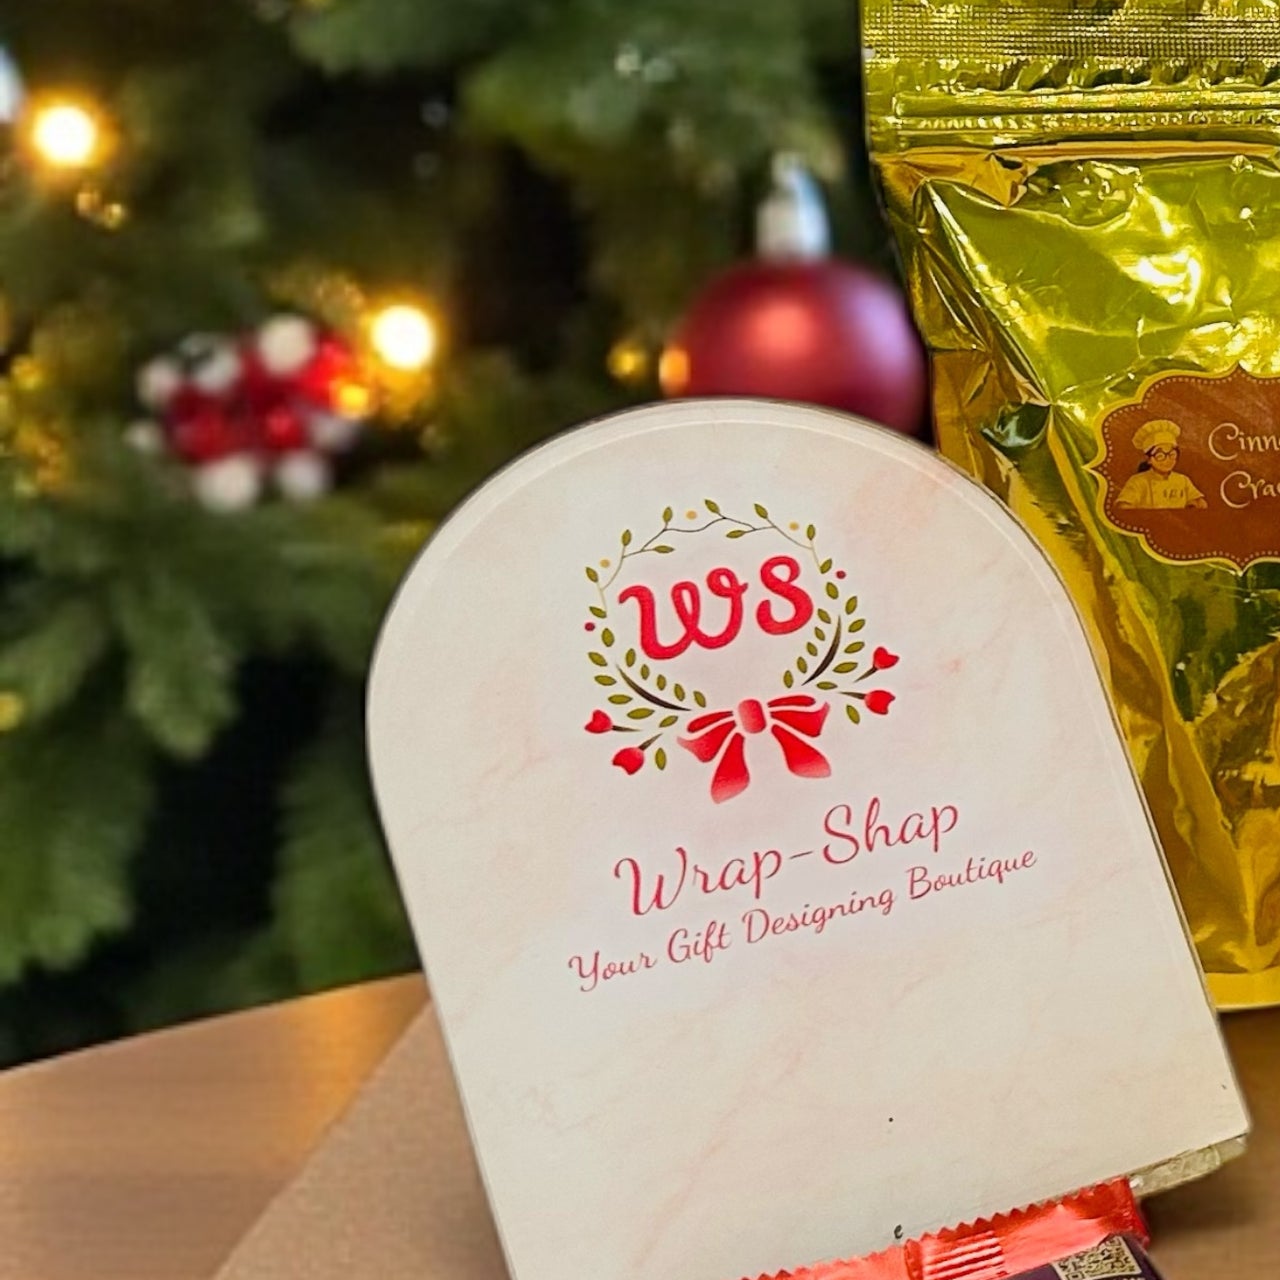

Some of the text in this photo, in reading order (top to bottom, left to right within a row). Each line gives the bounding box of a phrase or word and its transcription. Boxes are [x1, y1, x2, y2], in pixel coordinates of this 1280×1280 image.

[567, 849, 1039, 993] Your Gift Designing Boutique
[613, 796, 959, 916] Wrap-Shap
